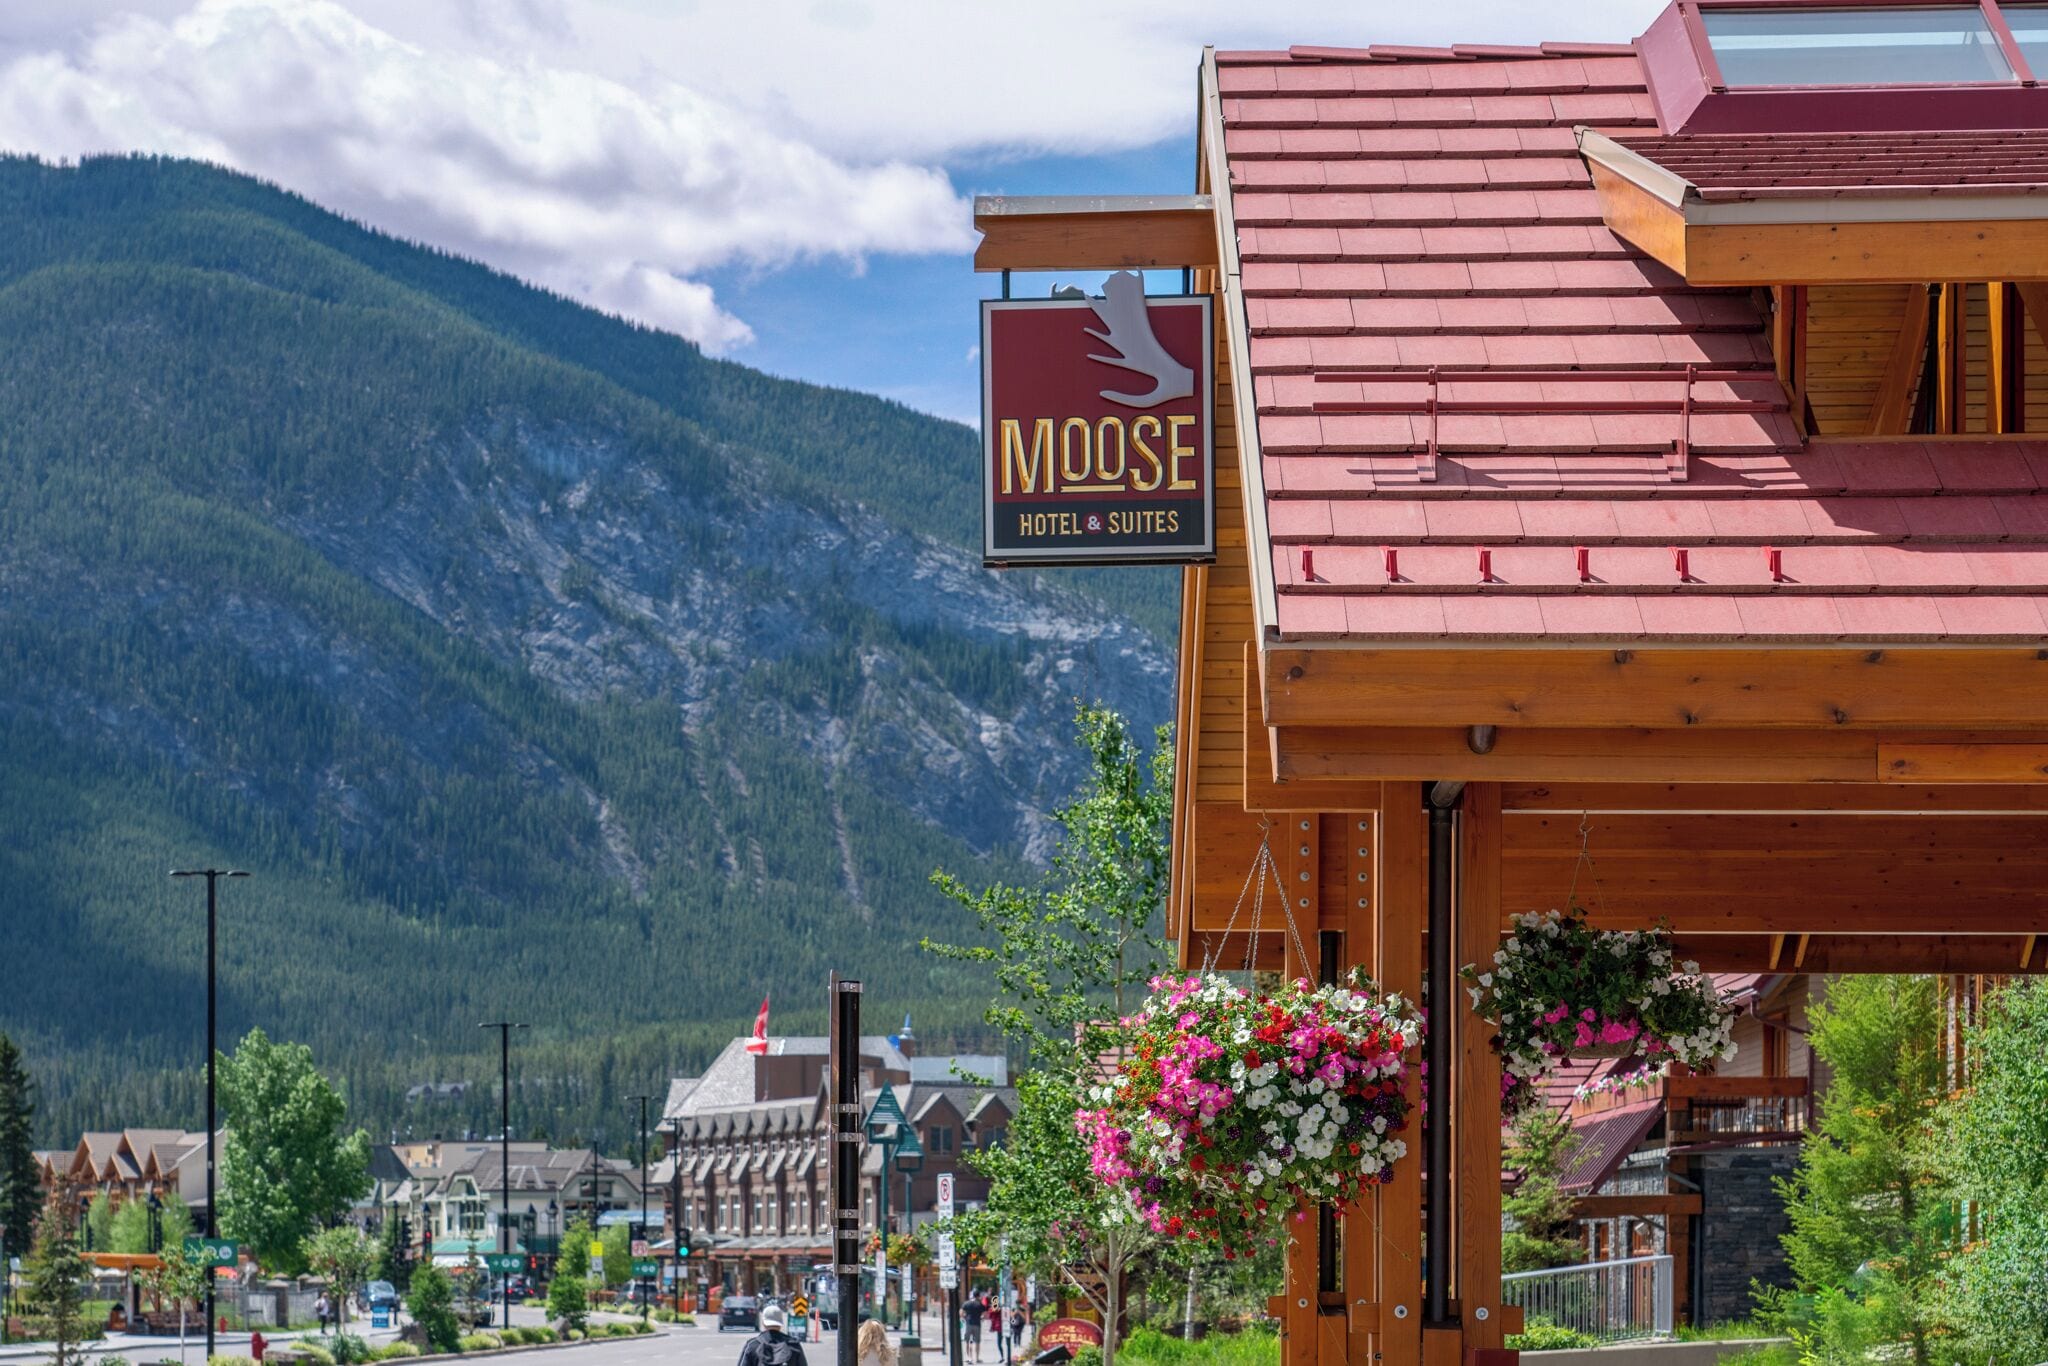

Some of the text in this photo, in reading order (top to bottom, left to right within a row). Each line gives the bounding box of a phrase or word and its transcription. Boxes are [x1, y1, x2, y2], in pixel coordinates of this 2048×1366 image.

[1000, 415, 1197, 495] MOOSE
[1019, 510, 1180, 537] HOTEL & SUITES
[1058, 1324, 1076, 1333] THE
[1041, 1332, 1097, 1346] MEATBALL
